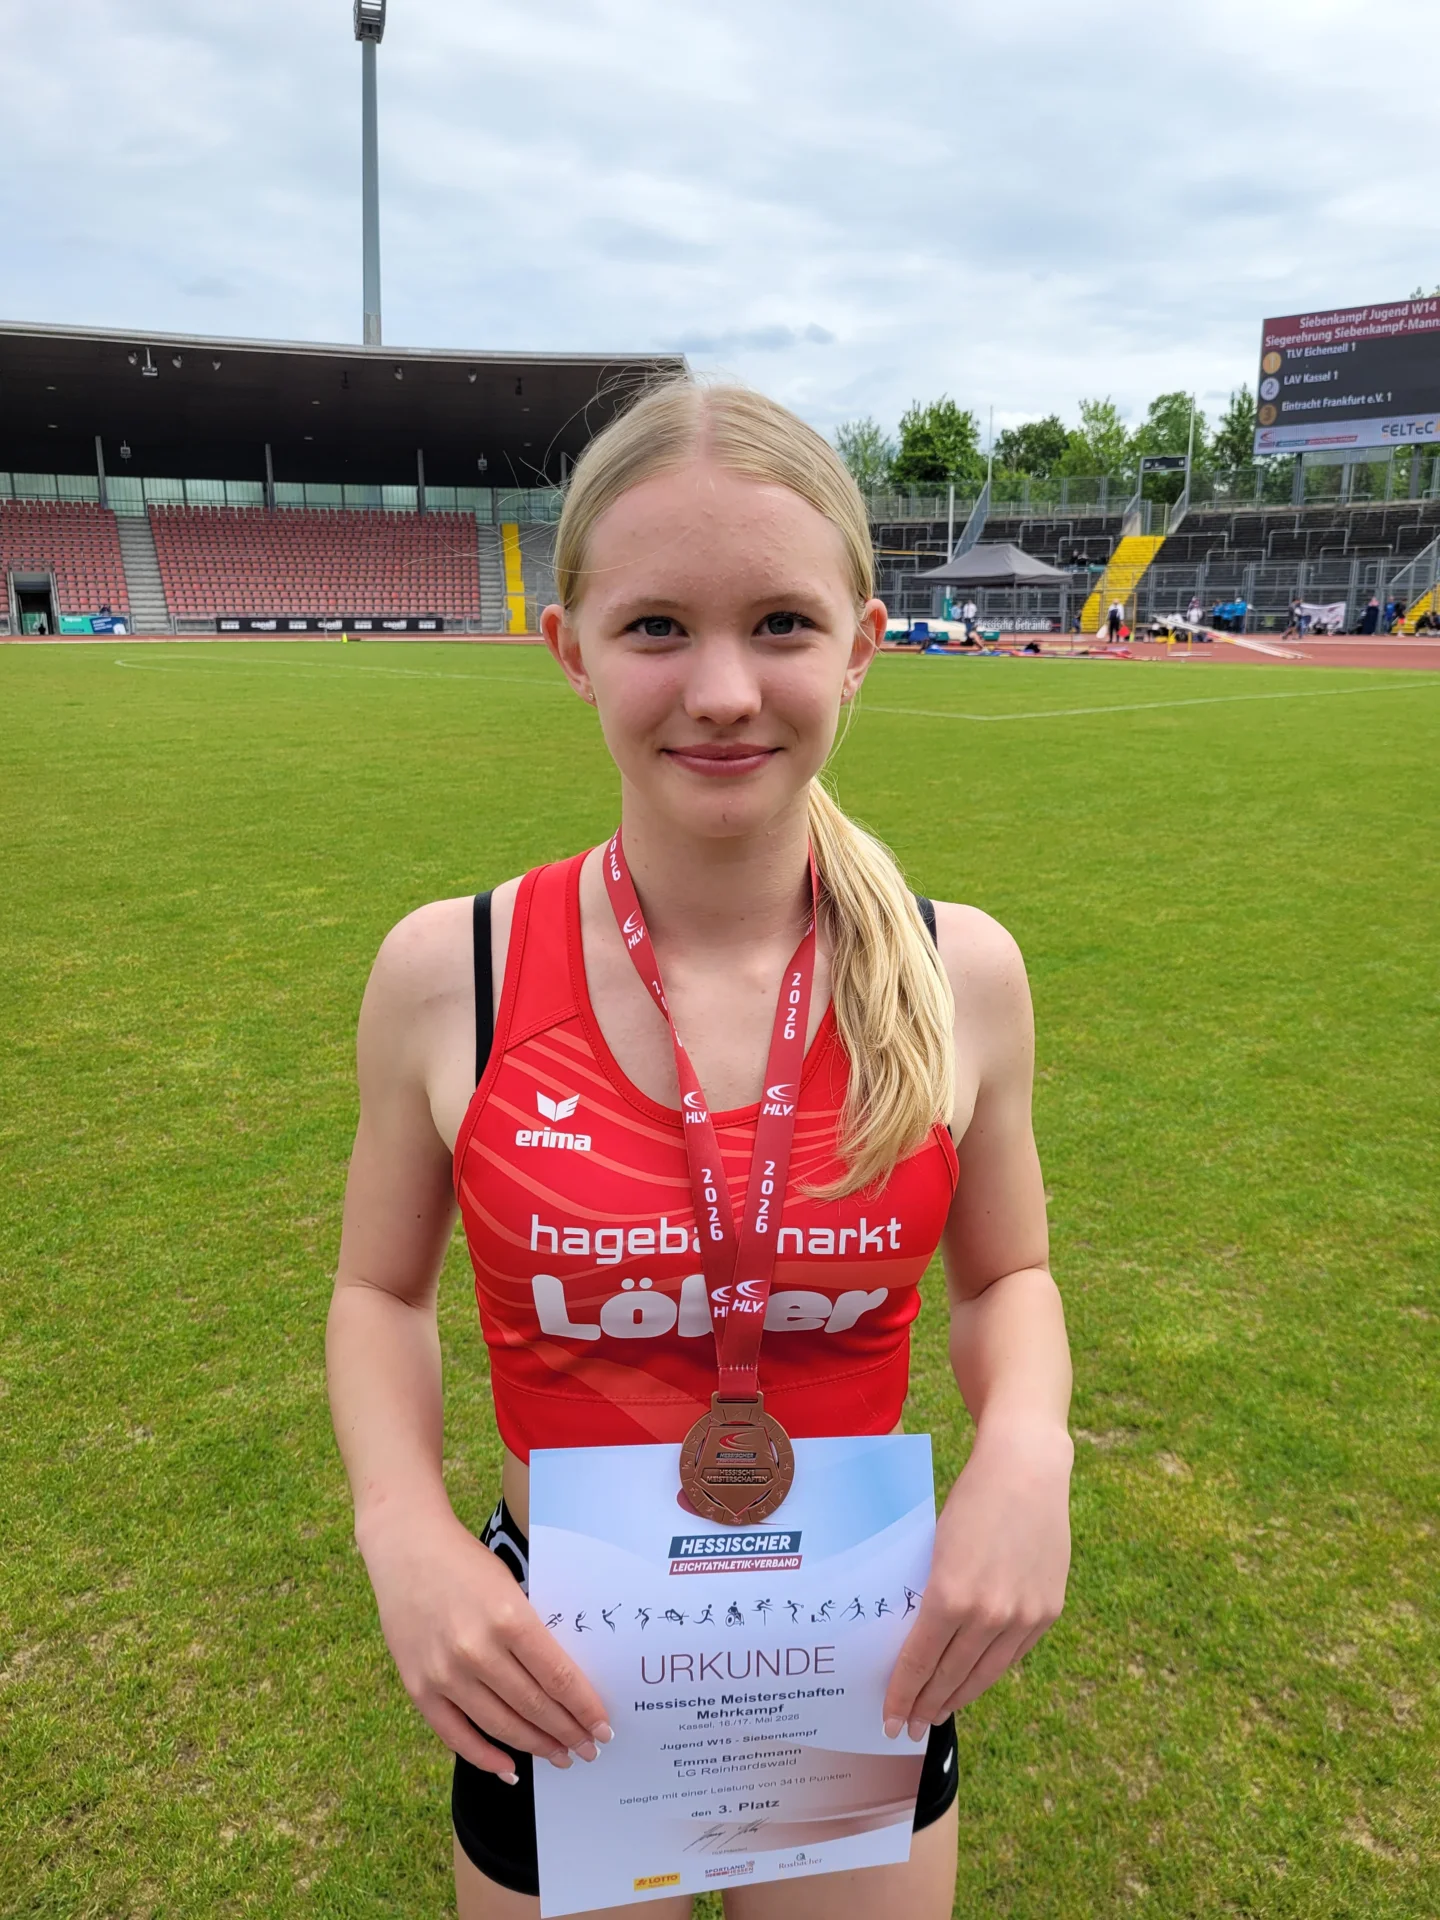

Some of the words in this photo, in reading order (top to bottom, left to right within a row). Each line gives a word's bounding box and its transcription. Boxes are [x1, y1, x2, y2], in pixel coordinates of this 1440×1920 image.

[1299, 309, 1368, 328] Siebenkampf
[1368, 303, 1409, 321] Jugend
[1411, 301, 1437, 314] W14
[1265, 331, 1332, 348] Siegerehrung
[1334, 318, 1440, 338] Siebenkampf-Mann
[1286, 349, 1303, 358] TLV
[1304, 343, 1349, 357] Eichenzell
[1352, 342, 1356, 351] 1
[1284, 375, 1301, 385] LAV
[1303, 371, 1331, 383] Kassel
[1333, 370, 1338, 380] 1
[1265, 381, 1274, 395] 2
[1281, 399, 1321, 411] Eintracht
[1322, 394, 1366, 408] Frankfurt
[1367, 393, 1384, 403] e.V.
[1387, 392, 1392, 401] 1
[627, 925, 645, 949] HLV
[783, 972, 801, 1039] 2026
[686, 1111, 707, 1123] HLV
[763, 1103, 794, 1116] HLV
[515, 1126, 592, 1152] erima
[701, 1168, 723, 1241] 2026
[755, 1160, 775, 1234] 2026
[732, 1299, 764, 1313] HLV
[680, 1535, 791, 1554] HESSISCHER
[672, 1558, 799, 1572] LEICHTATHLETIK-VERBAND
[641, 1646, 835, 1684] URKUNDE
[634, 1696, 716, 1711] Hessische
[721, 1687, 845, 1704] Meisterschaften
[697, 1704, 785, 1720] Mehrkampf
[679, 1721, 715, 1731] Kassel,
[719, 1718, 751, 1727] 16./17.
[755, 1716, 773, 1725] Mai
[775, 1714, 800, 1722] 2026
[660, 1740, 703, 1750] Jugend
[707, 1738, 732, 1746] W15
[743, 1729, 818, 1743] Siebenkampf
[673, 1757, 717, 1767] Emma
[722, 1748, 802, 1763] Brachmann
[677, 1769, 697, 1778] LG
[701, 1757, 797, 1775] Reinhardswald
[619, 1794, 659, 1805] belegte
[662, 1791, 678, 1800] mit
[681, 1789, 707, 1798] einer
[710, 1783, 755, 1795] Leistung
[758, 1781, 777, 1789] von
[780, 1776, 806, 1786] 3418
[809, 1773, 852, 1784] Punkten
[691, 1809, 712, 1817] den
[718, 1804, 732, 1814] 3.
[738, 1799, 780, 1811] Platz
[704, 1864, 745, 1874] SPORTLAND
[649, 1874, 678, 1884] LOTTO
